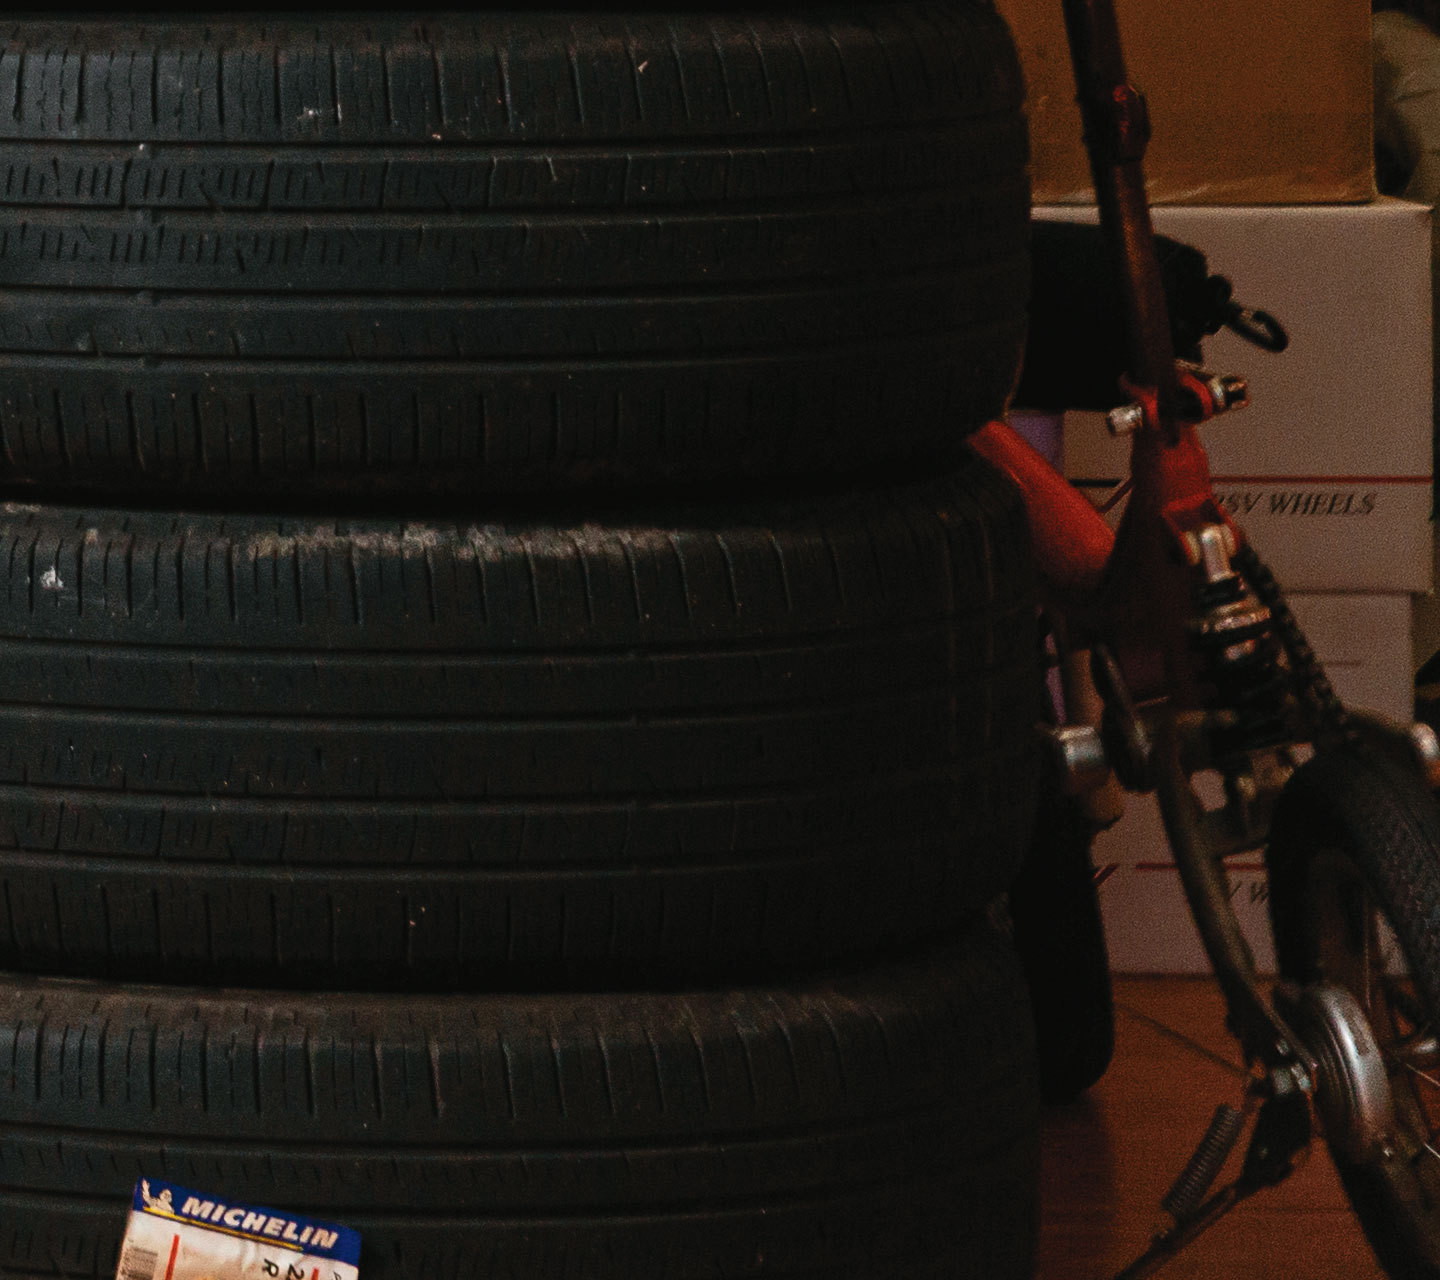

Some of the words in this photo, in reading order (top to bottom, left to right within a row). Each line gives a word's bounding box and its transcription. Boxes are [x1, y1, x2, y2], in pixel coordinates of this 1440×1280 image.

[1212, 491, 1263, 515] SV
[1268, 491, 1378, 516] WHEELS
[181, 1195, 340, 1251] MICHELIN
